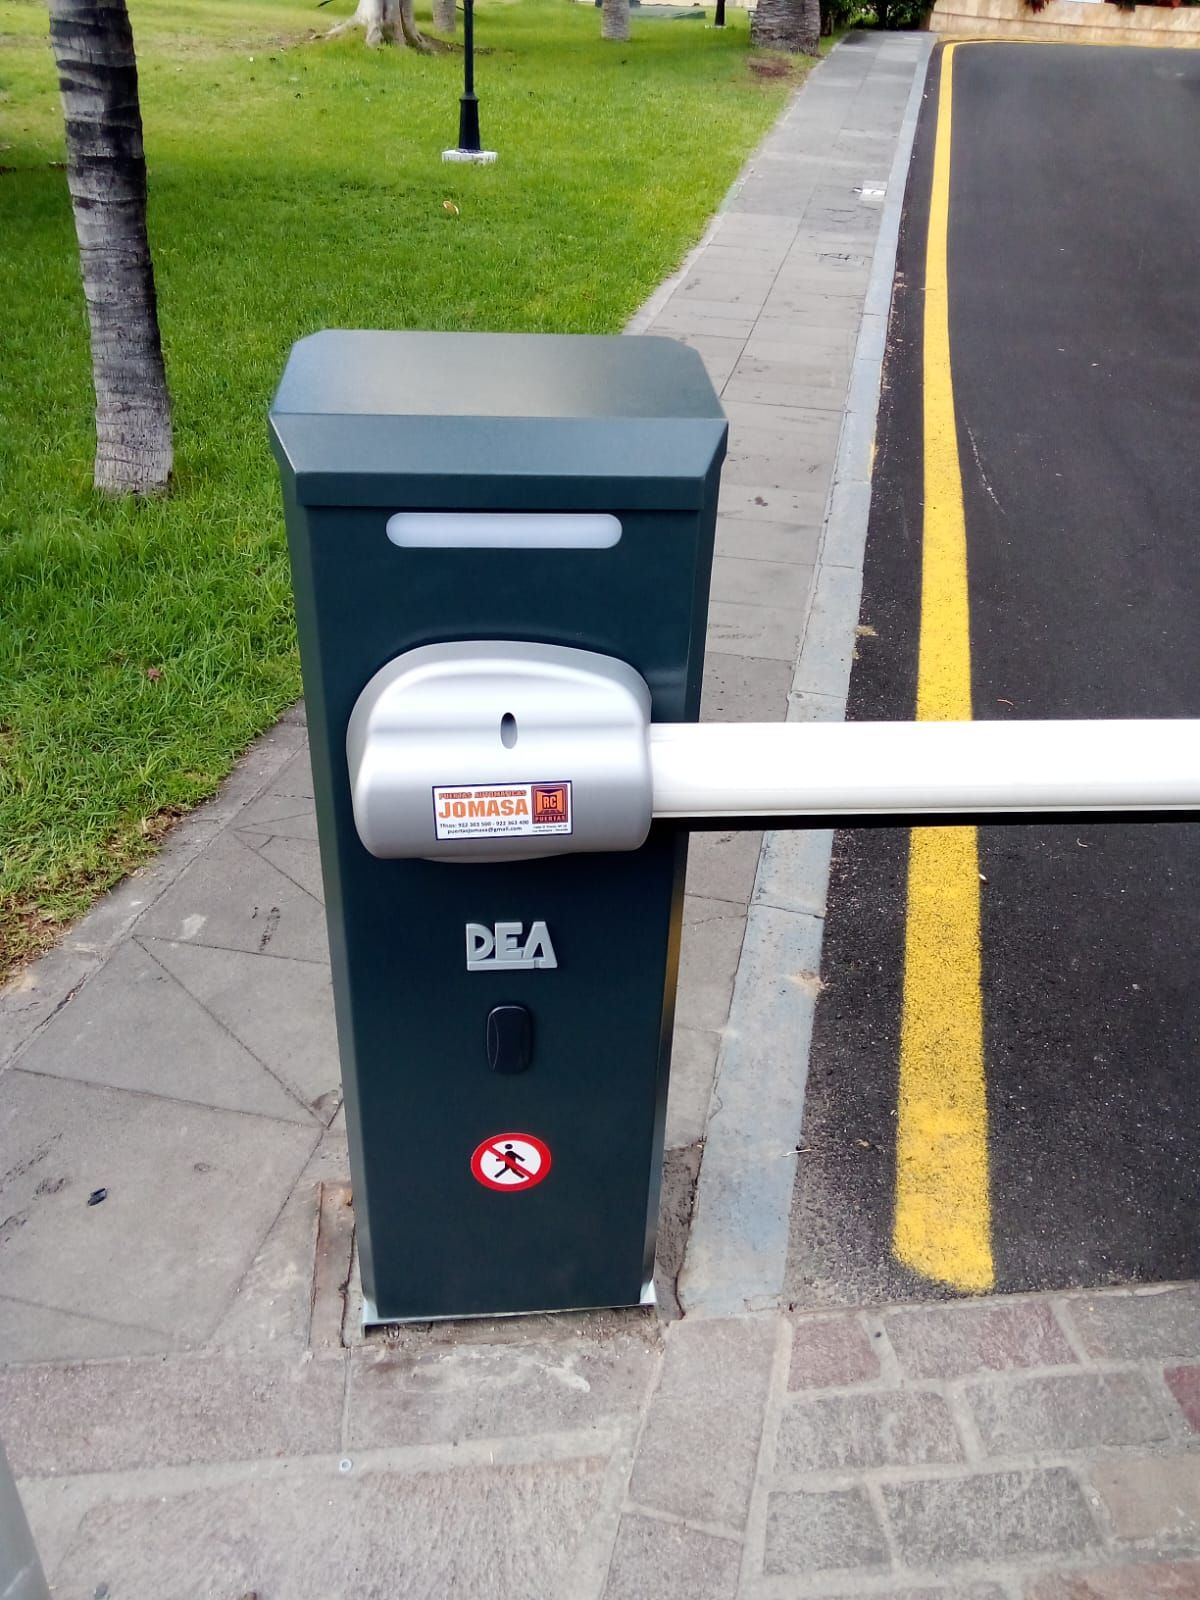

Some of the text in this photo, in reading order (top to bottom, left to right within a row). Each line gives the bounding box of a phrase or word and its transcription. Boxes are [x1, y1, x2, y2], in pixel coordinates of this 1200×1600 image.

[438, 799, 530, 819] JOMASA
[543, 796, 557, 809] RC
[465, 921, 558, 971] DEA
